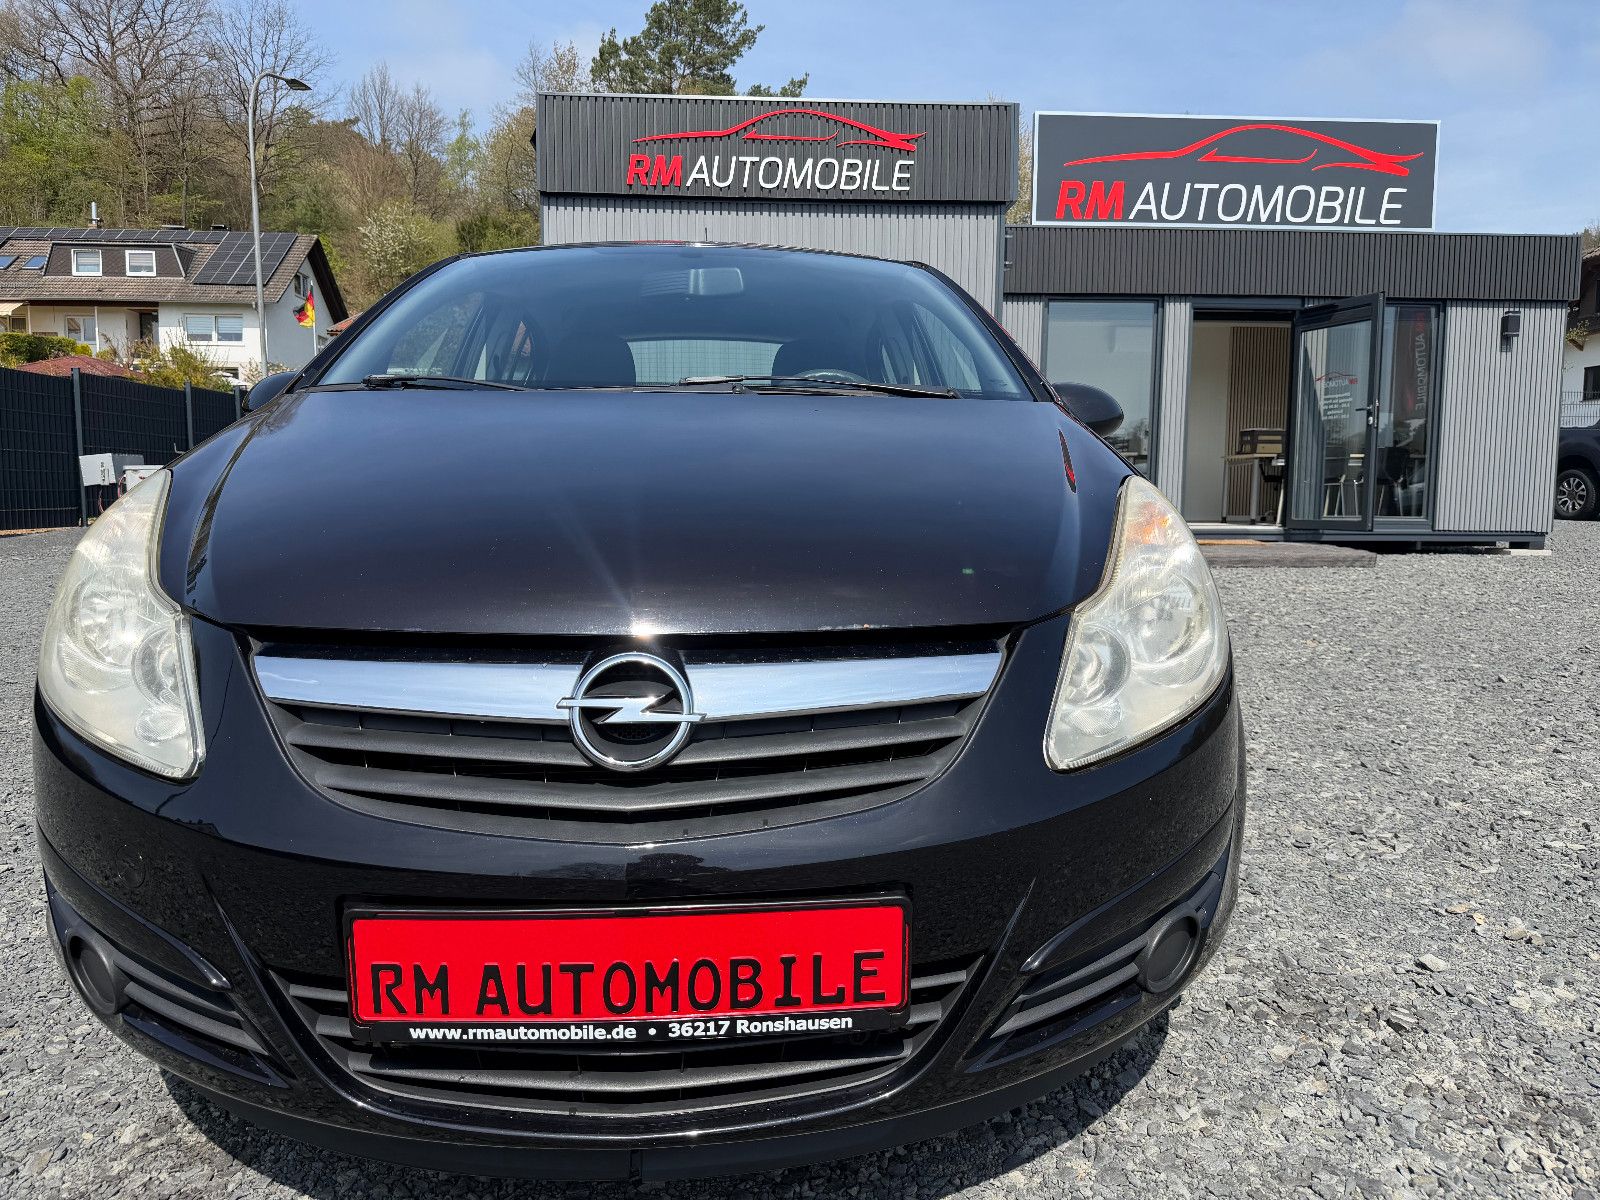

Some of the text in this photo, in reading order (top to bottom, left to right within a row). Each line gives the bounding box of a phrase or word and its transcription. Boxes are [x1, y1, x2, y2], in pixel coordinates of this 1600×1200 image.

[626, 154, 916, 192] RM AUTOMOBILE
[1055, 180, 1408, 225] RM AUTOMOBILE
[370, 951, 887, 1015] RM AUTOMOBILE
[409, 1017, 853, 1041] www.rmautomobile.de 36217 Ronshausen
